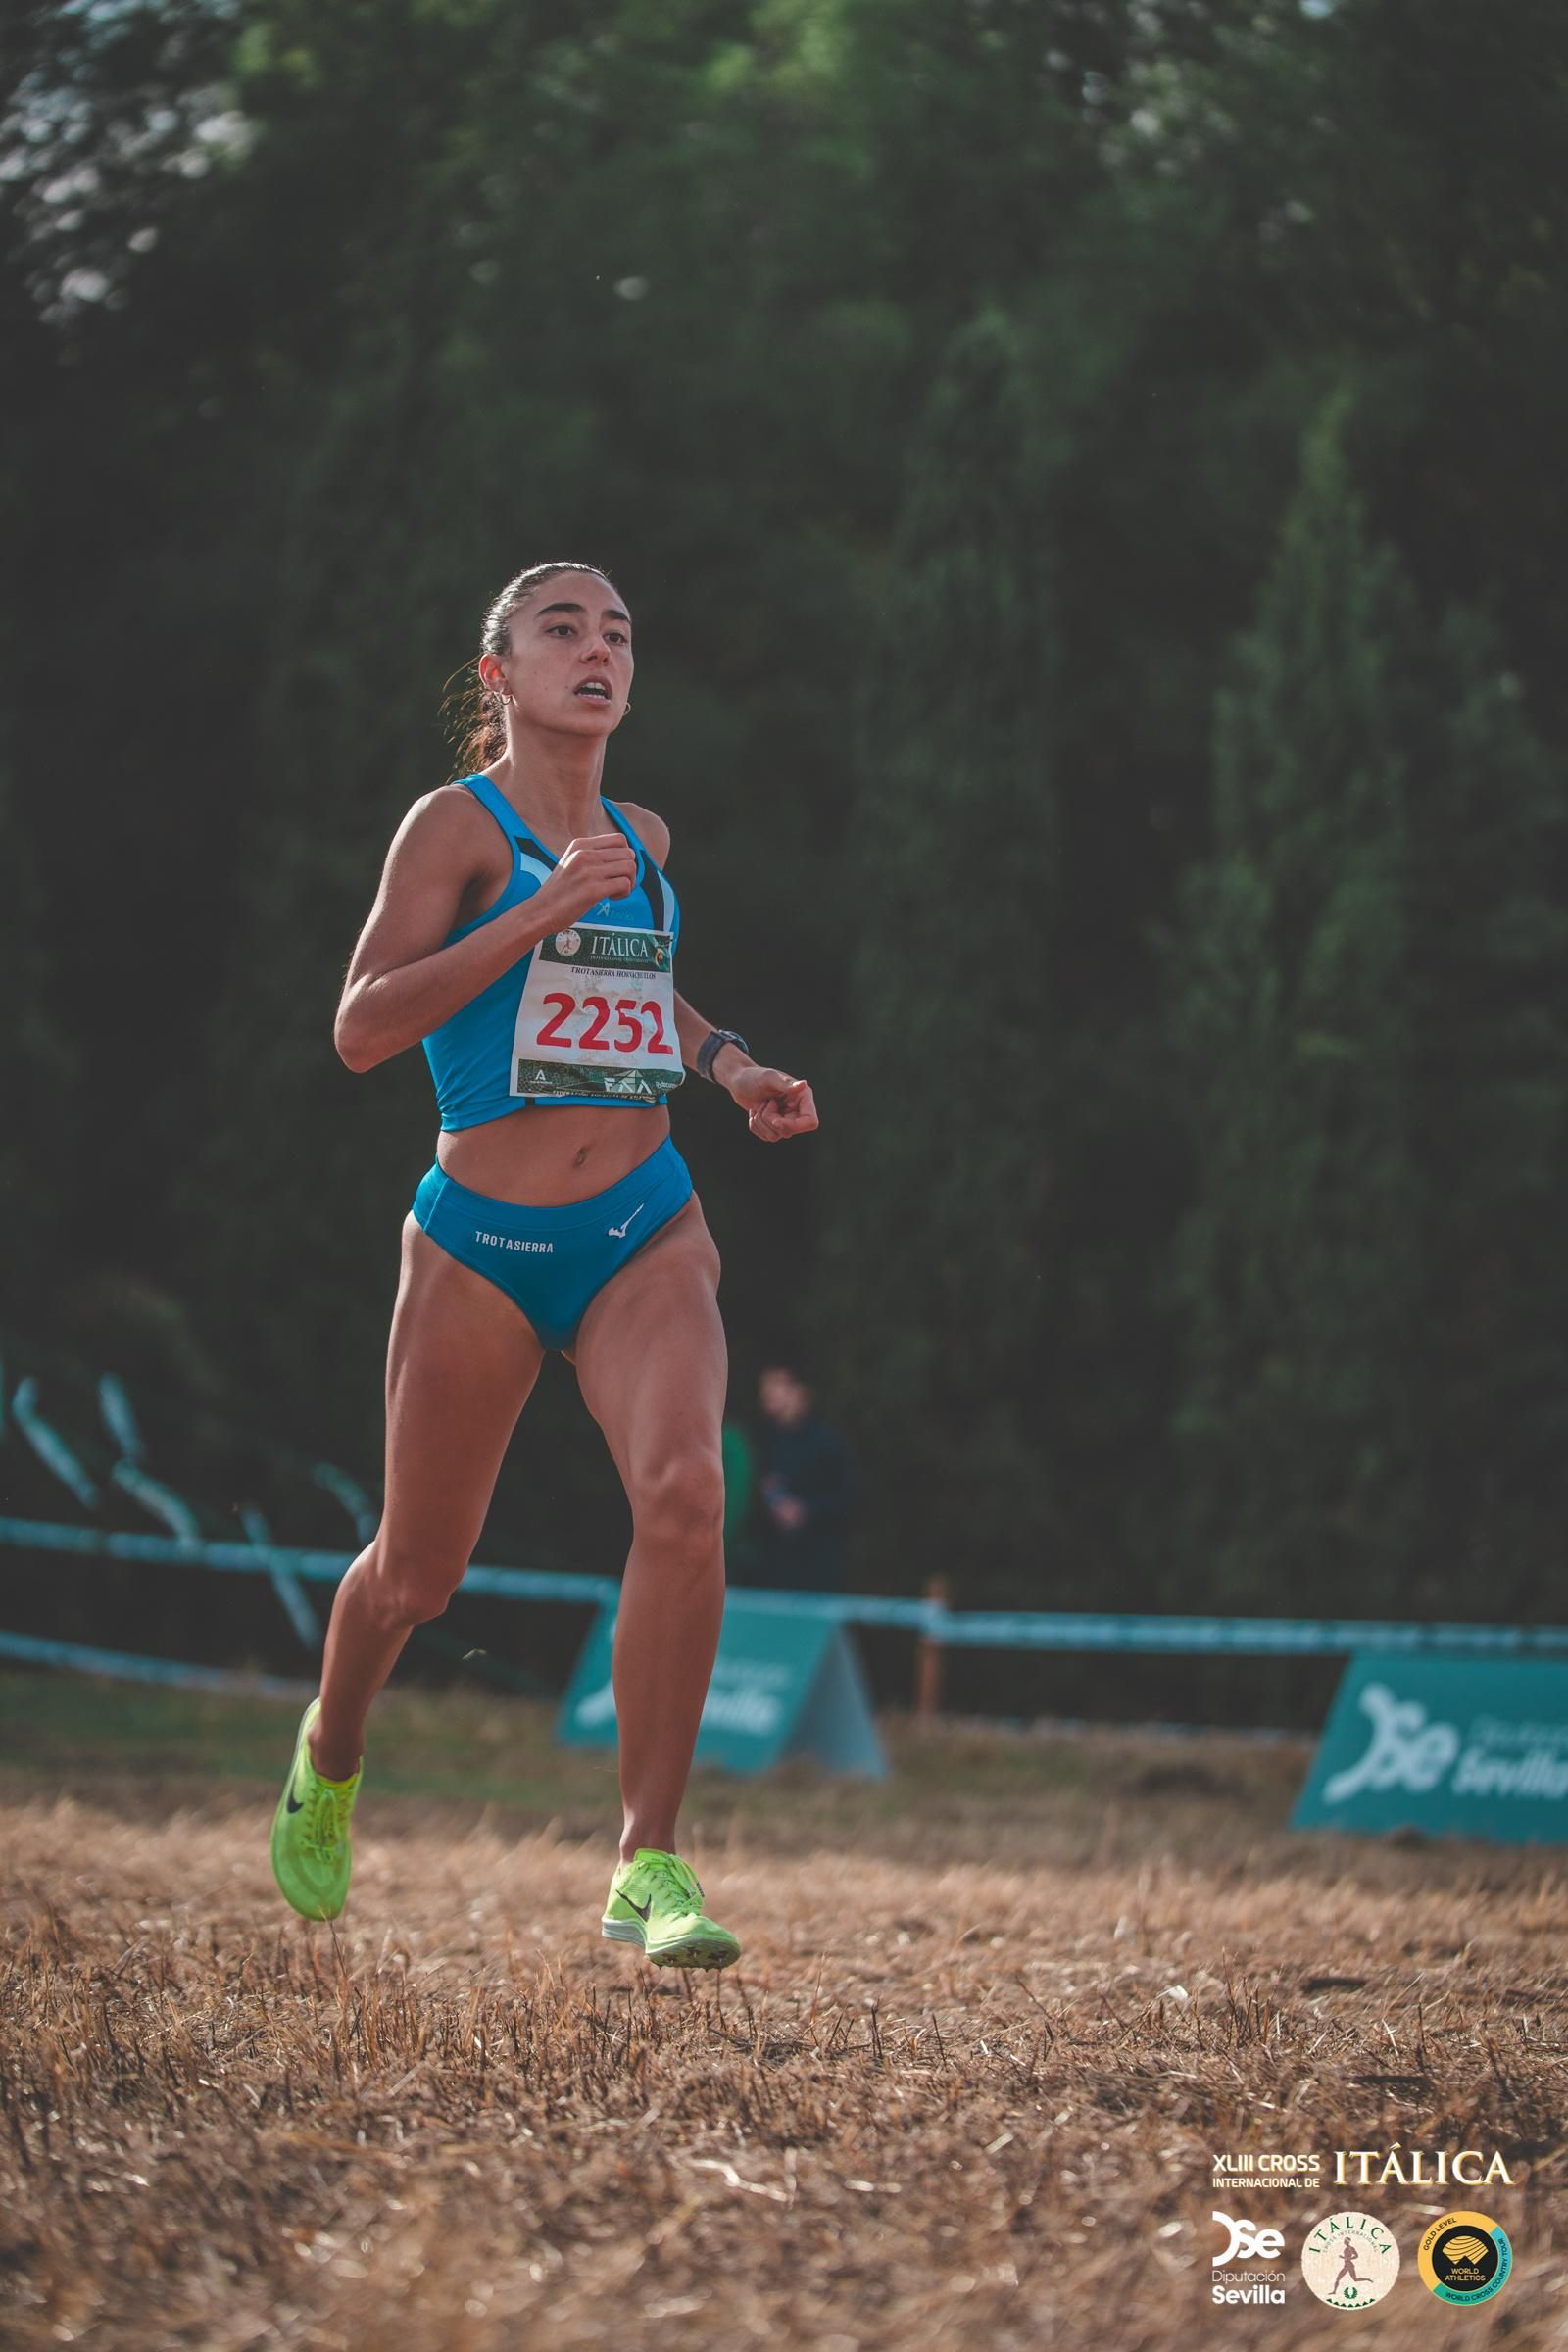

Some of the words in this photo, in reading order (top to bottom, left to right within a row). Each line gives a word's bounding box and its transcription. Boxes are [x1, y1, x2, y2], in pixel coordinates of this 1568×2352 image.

[590, 933, 649, 957] ITÁLICA
[571, 966, 615, 977] TROTASIERRA
[536, 992, 674, 1055] 2252
[475, 1231, 554, 1253] TROTASIERRA
